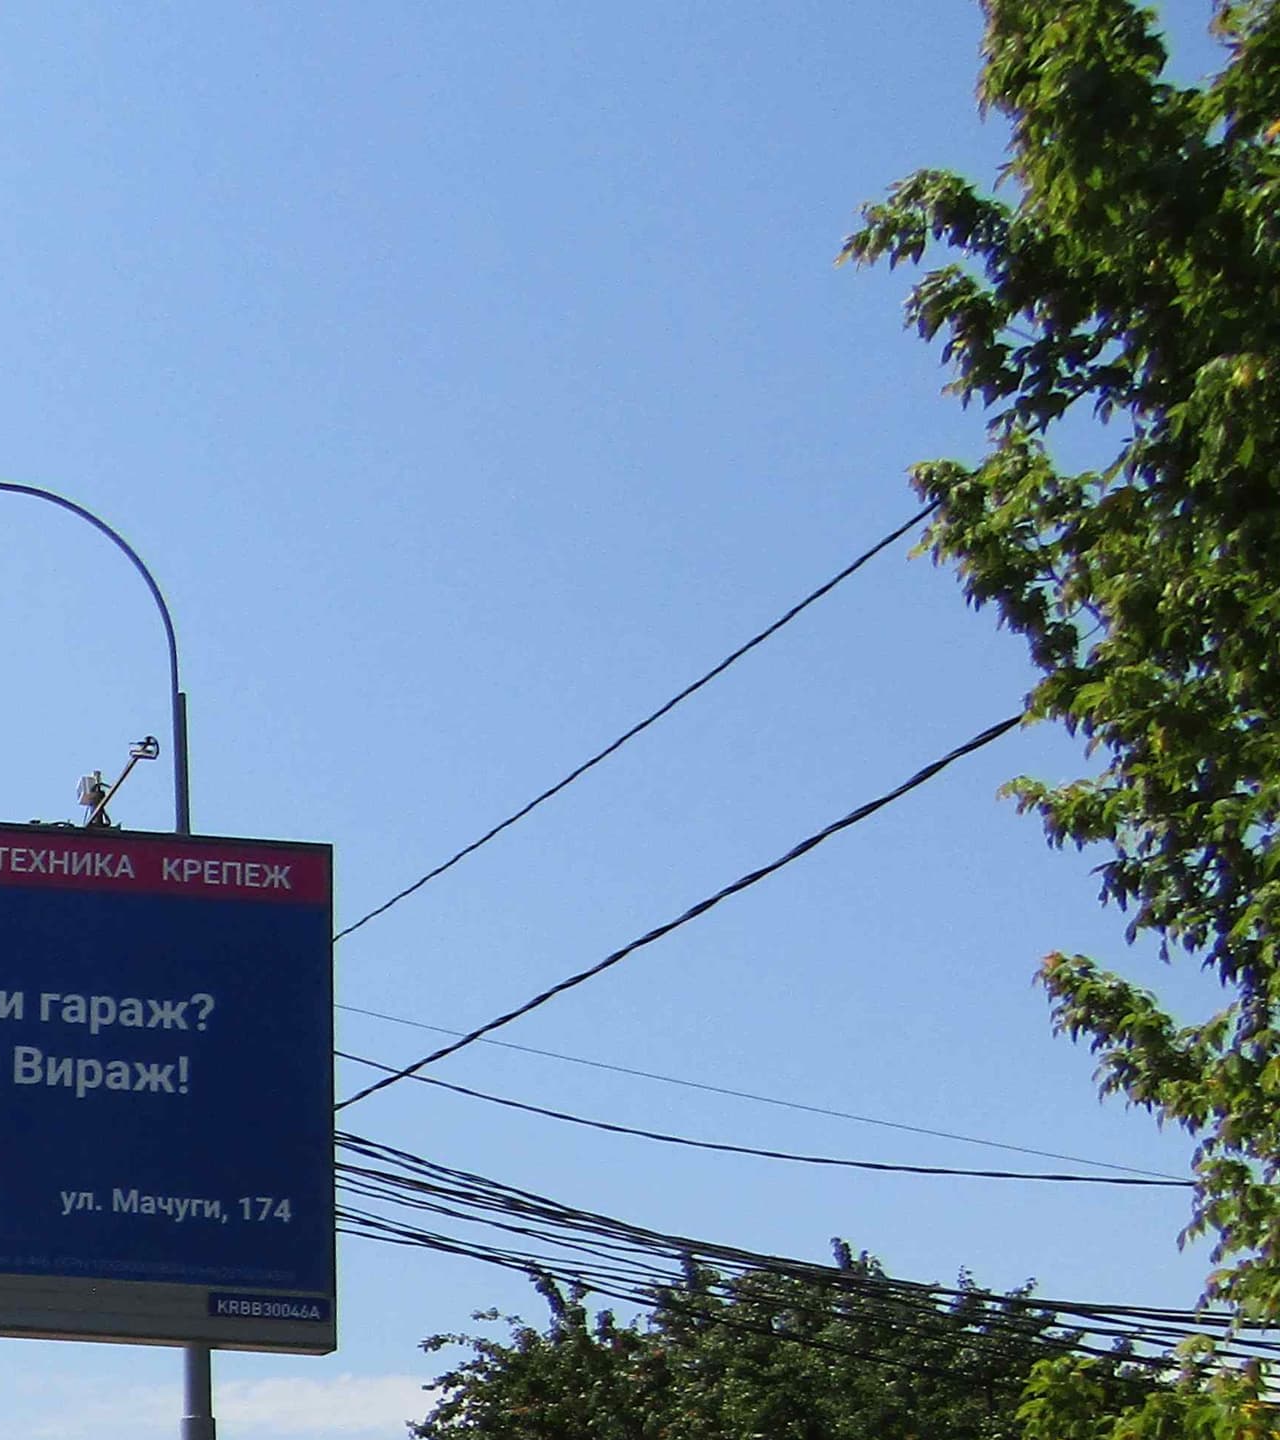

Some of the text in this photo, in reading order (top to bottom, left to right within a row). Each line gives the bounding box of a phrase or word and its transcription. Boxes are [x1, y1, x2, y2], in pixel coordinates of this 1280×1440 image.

[162, 857, 292, 889] КРЕПЕЖ
[39, 993, 215, 1034] гараж?
[13, 1046, 189, 1098] Вираж!
[60, 1188, 291, 1223] ул. Мачуги, 174
[217, 1300, 320, 1320] KRBB30046A
